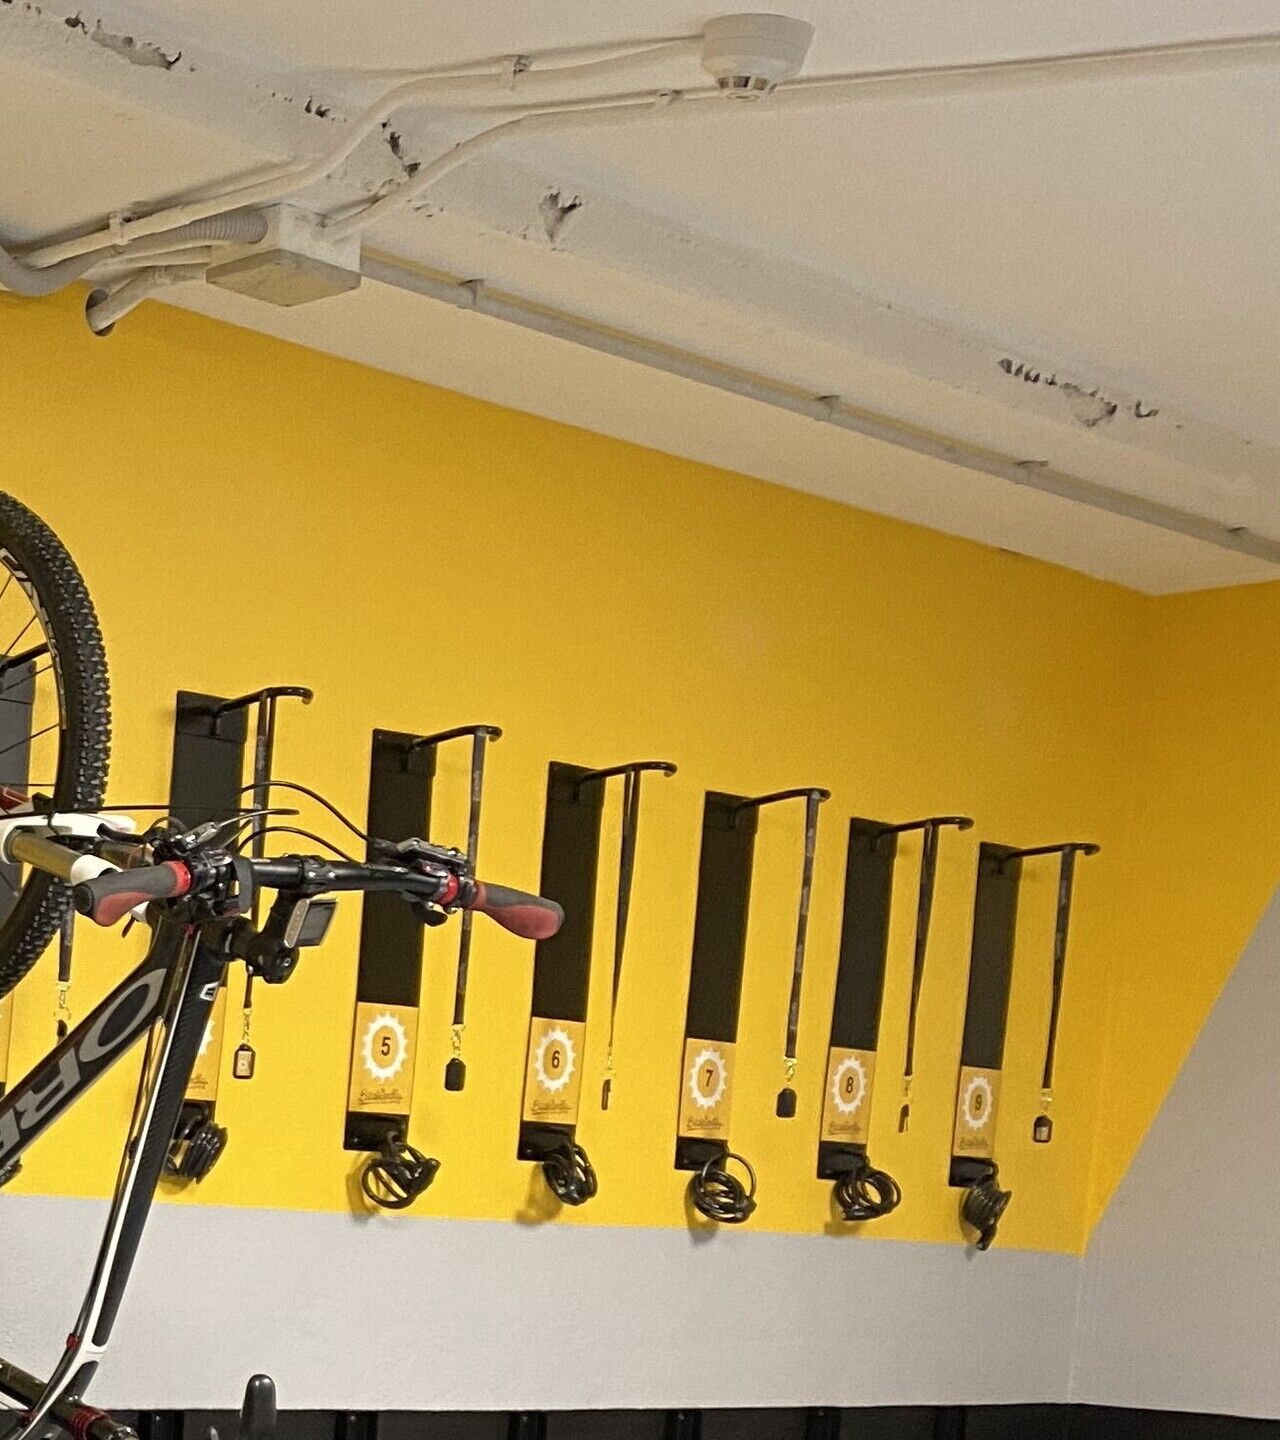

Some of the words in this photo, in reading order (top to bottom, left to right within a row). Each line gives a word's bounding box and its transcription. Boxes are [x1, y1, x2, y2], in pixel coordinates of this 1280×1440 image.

[381, 1036, 391, 1056] 5
[551, 1050, 560, 1069] 6
[705, 1069, 714, 1087] 7
[846, 1076, 854, 1093] 8
[975, 1094, 983, 1111] 9
